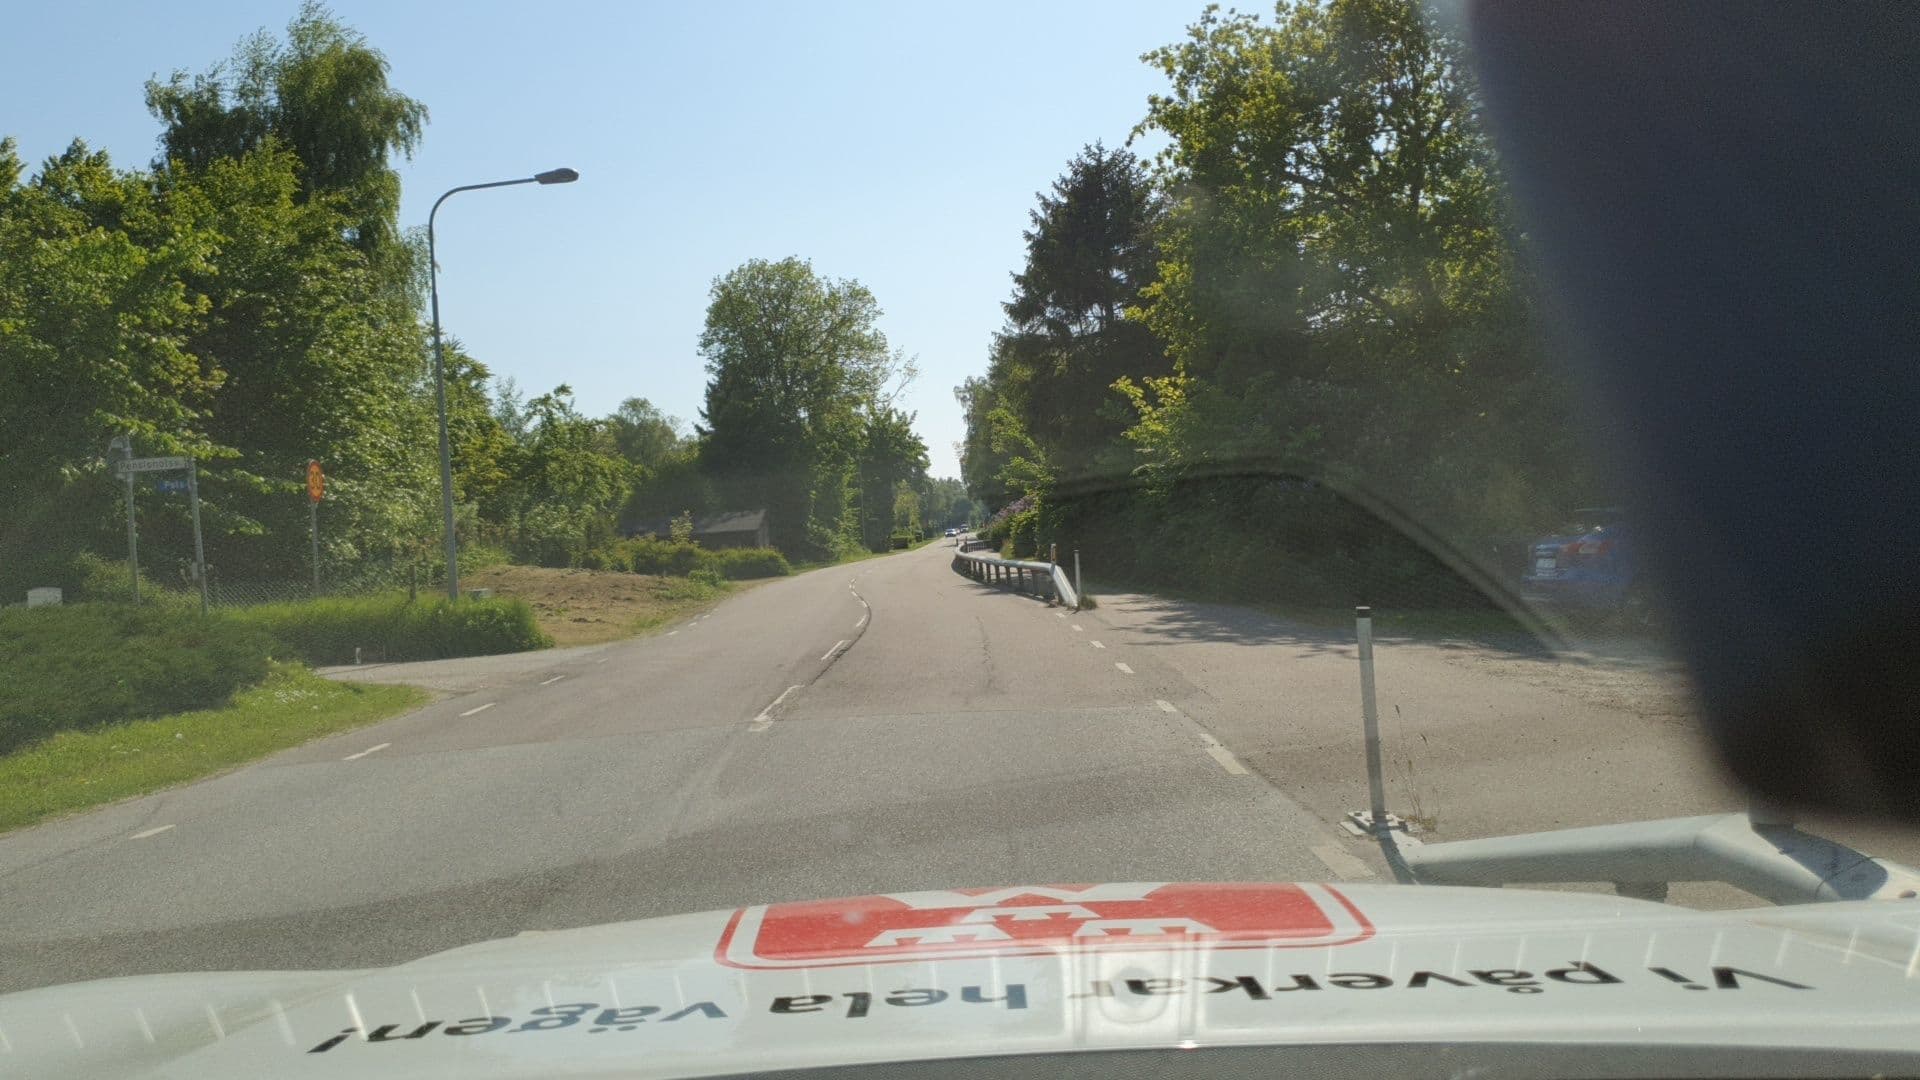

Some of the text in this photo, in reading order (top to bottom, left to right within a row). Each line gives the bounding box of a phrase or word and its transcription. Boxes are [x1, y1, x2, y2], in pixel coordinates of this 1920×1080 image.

[306, 961, 1817, 1053] Vi påverkar hela vägen!
